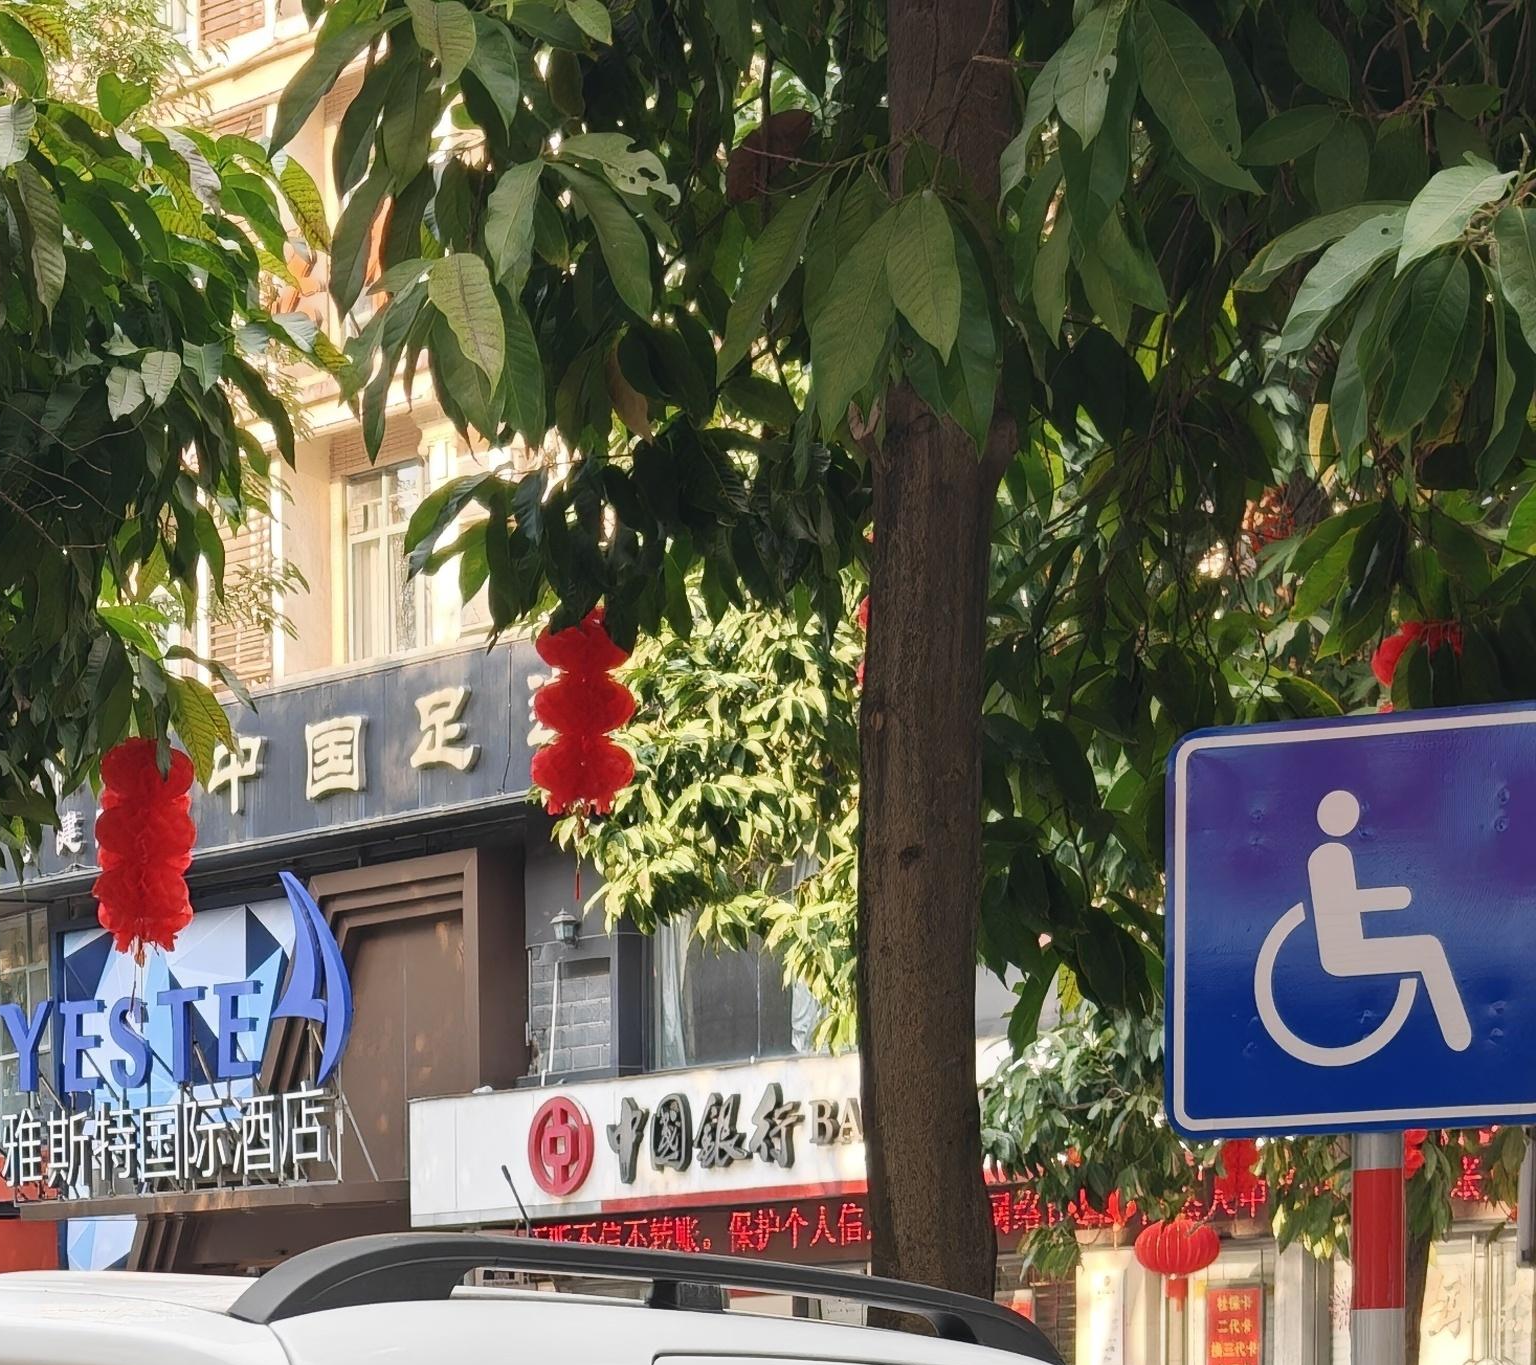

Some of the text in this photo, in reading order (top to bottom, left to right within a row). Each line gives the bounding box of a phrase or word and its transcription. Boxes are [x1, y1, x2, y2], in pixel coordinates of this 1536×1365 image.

[0, 979, 264, 1093] YESTE
[1, 1083, 330, 1188] 雅斯特国际酒店
